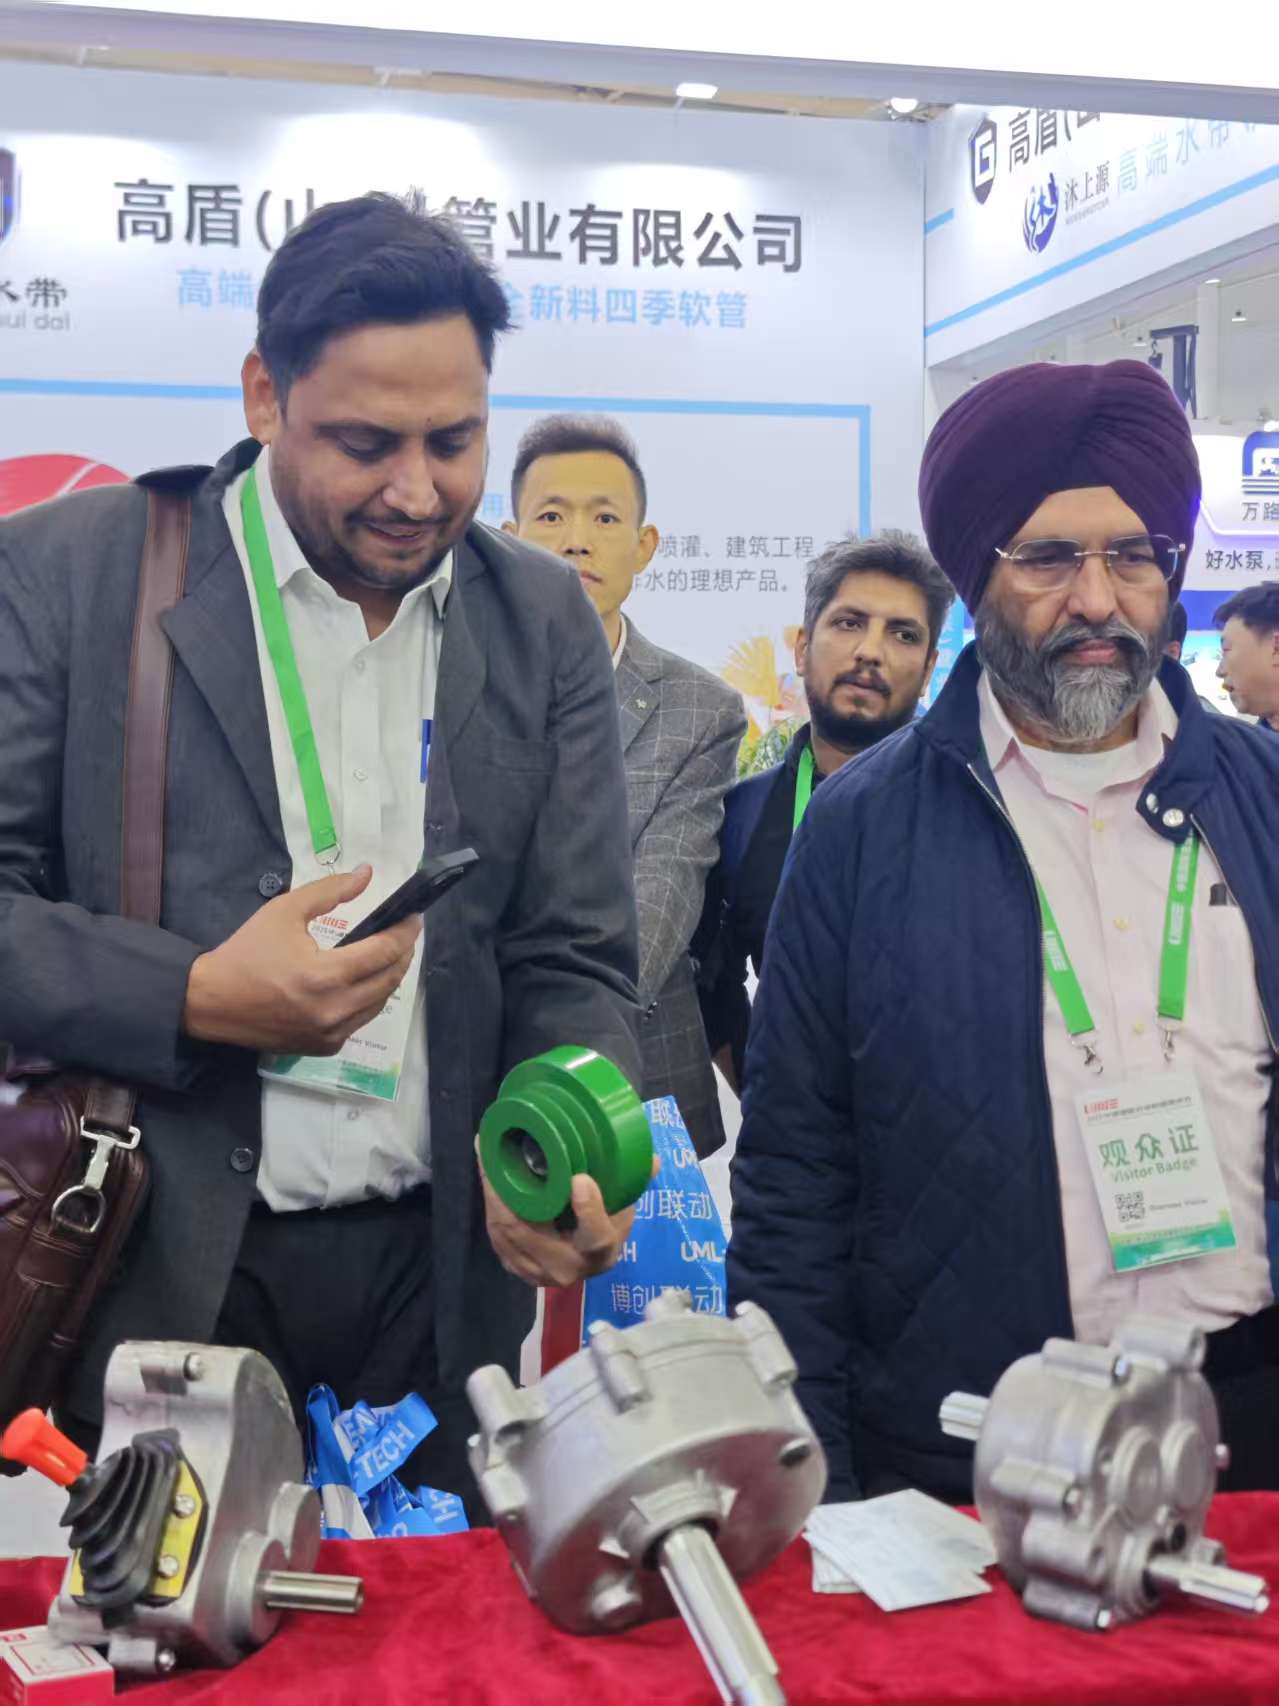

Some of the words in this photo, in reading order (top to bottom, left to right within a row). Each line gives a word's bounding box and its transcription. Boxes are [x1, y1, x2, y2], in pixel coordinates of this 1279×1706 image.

[635, 567, 789, 593] 水的理想产品。
[1099, 1123, 1200, 1170] 观众证
[1110, 1165, 1154, 1183] Visitor
[1155, 1157, 1199, 1176] Badge
[611, 1283, 723, 1316] 博创动
[355, 1419, 416, 1479] TECH
